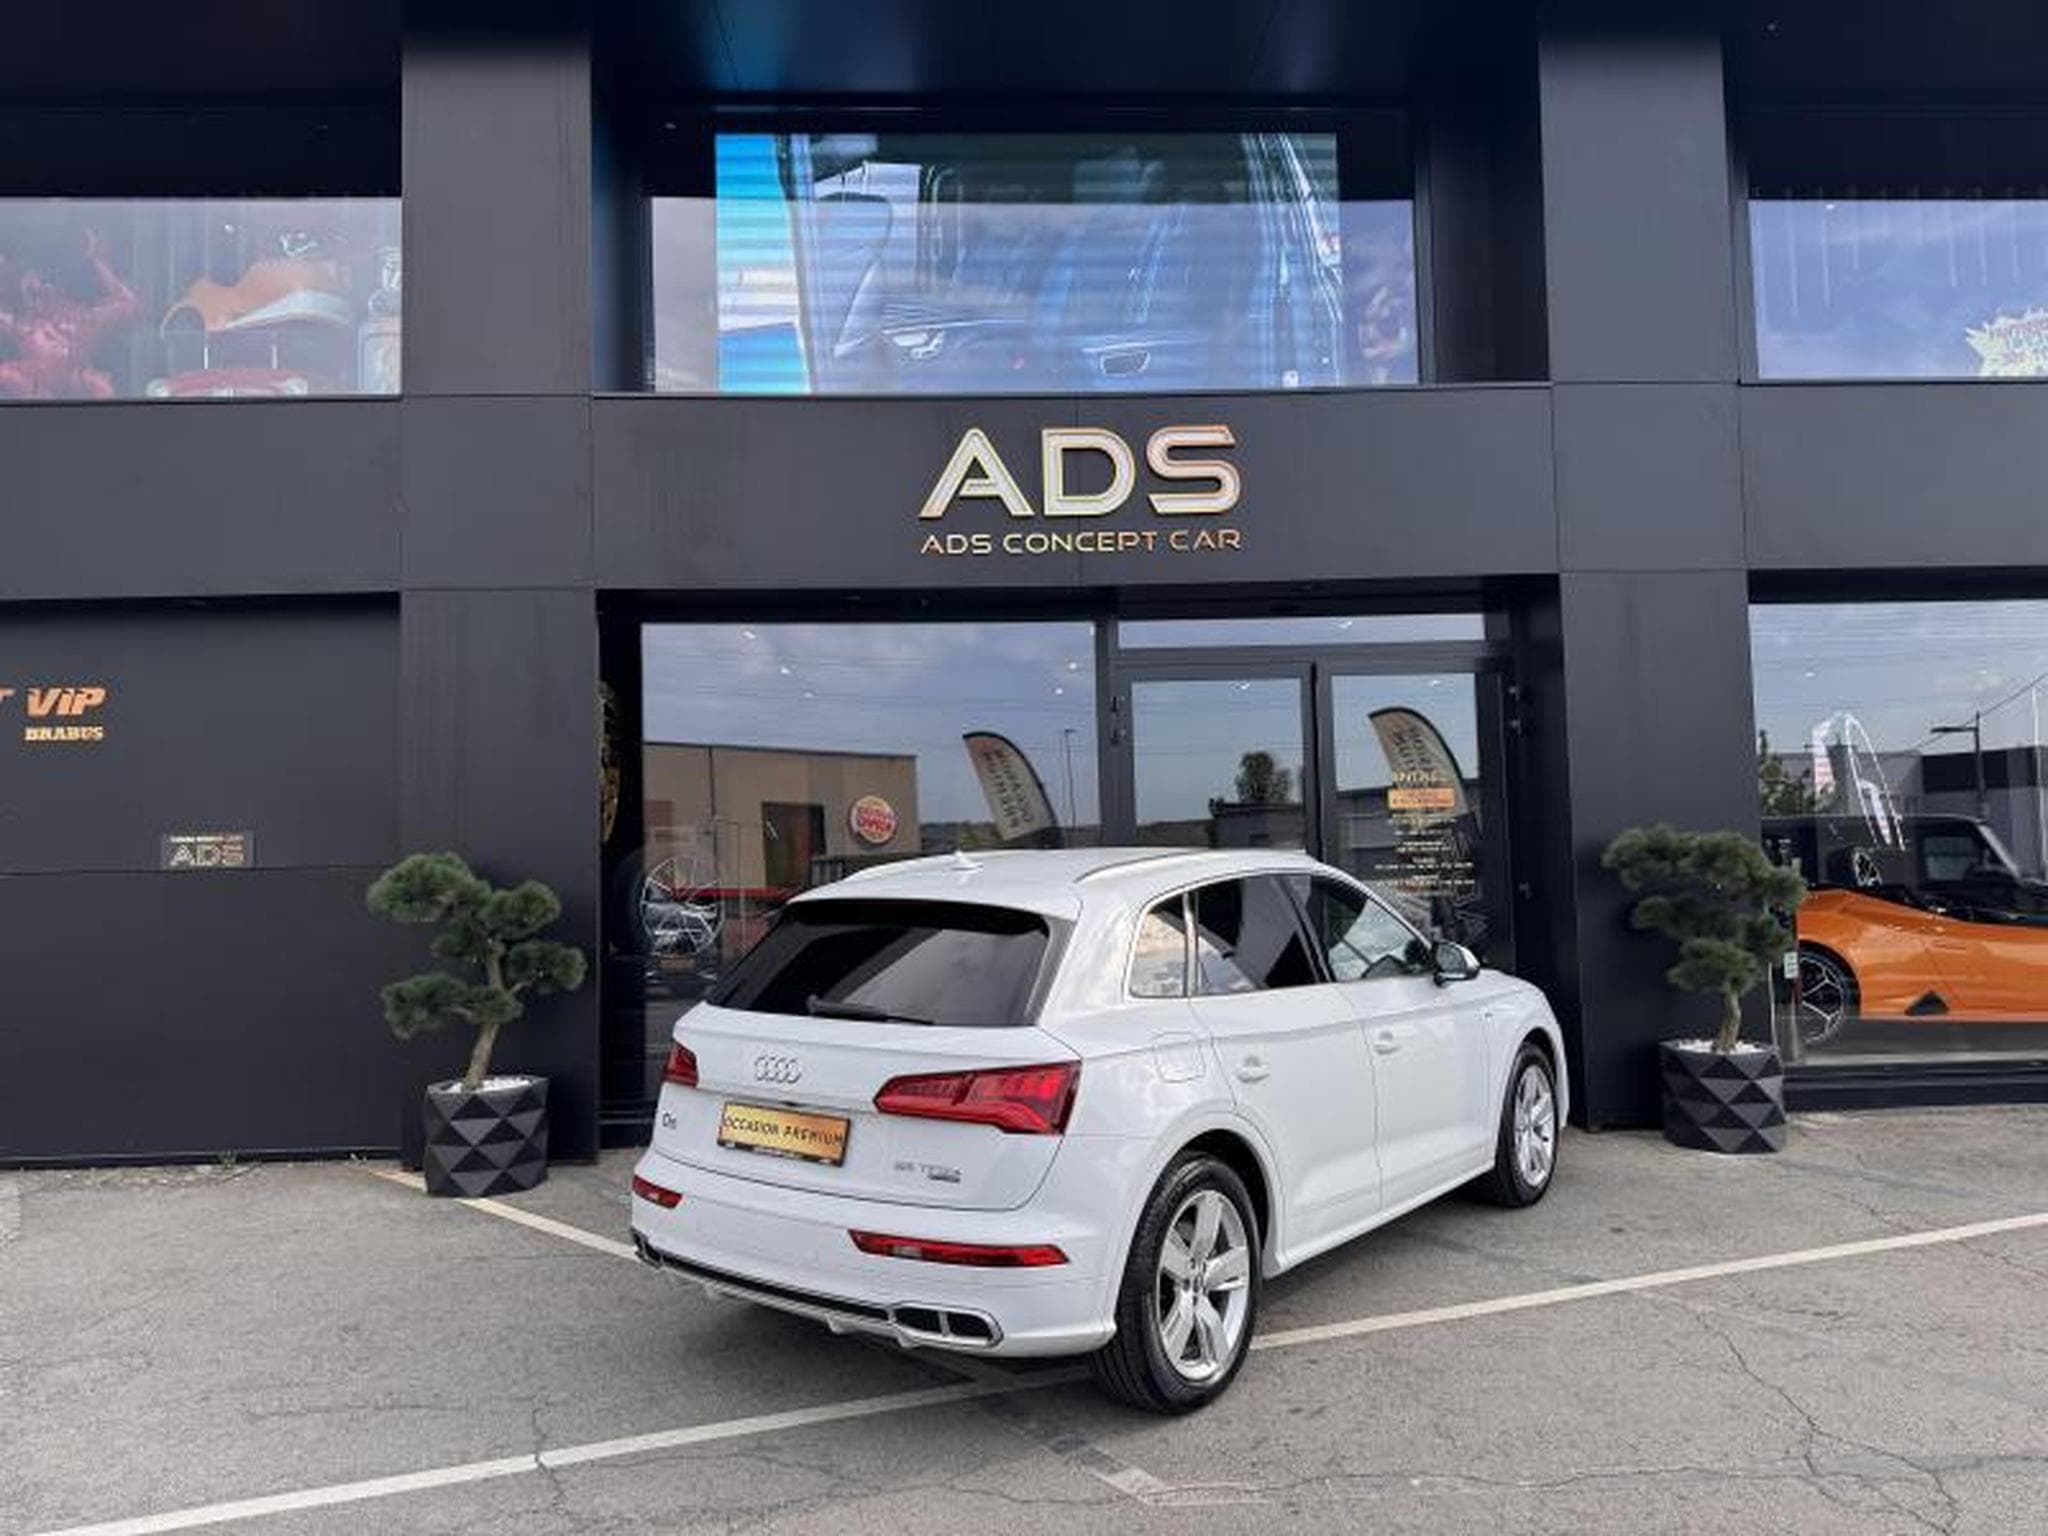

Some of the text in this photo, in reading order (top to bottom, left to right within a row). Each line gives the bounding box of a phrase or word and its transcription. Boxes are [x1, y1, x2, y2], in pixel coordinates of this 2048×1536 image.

[918, 424, 1242, 518] ADS
[920, 529, 1242, 554] ADS CONCEPT CAR
[25, 726, 104, 741] BRABUS
[169, 844, 245, 867] ADS
[722, 1114, 844, 1146] OCCASION PREMIUM
